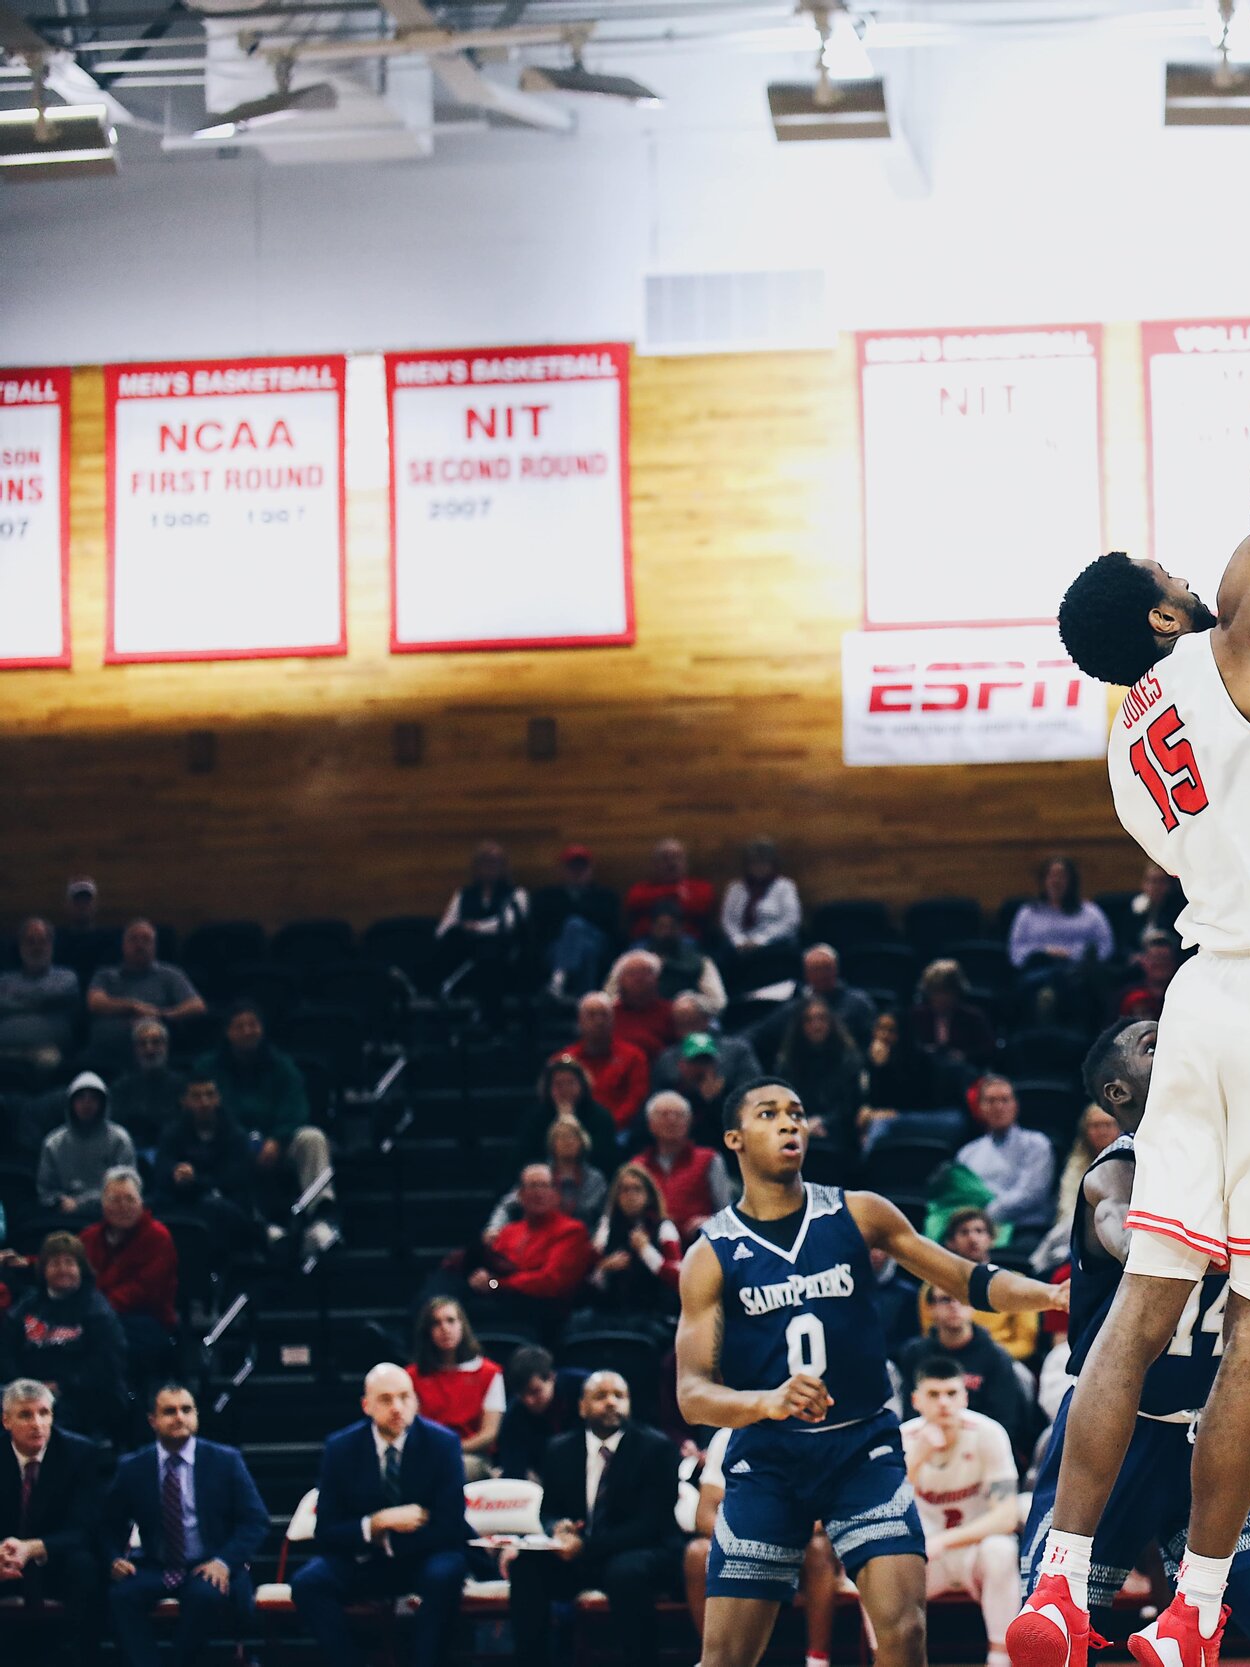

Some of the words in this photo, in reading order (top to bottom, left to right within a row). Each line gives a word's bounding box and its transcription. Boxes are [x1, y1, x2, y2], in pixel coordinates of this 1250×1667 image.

[118, 371, 190, 397] MEN'S
[192, 364, 337, 395] BASKETBALL
[395, 359, 468, 385] MEN'S
[471, 352, 618, 383] BASKETBALL
[940, 384, 1016, 416] NIT
[159, 420, 294, 453] NCAA
[465, 404, 551, 439] NIT
[131, 470, 212, 494] FIRST
[225, 466, 324, 490] ROUND
[409, 458, 511, 485] SECOND
[519, 453, 608, 479] ROUND
[869, 660, 1080, 712] ESPN
[1123, 666, 1162, 730] JONES
[1130, 704, 1209, 834] 15
[785, 1313, 827, 1379] 0
